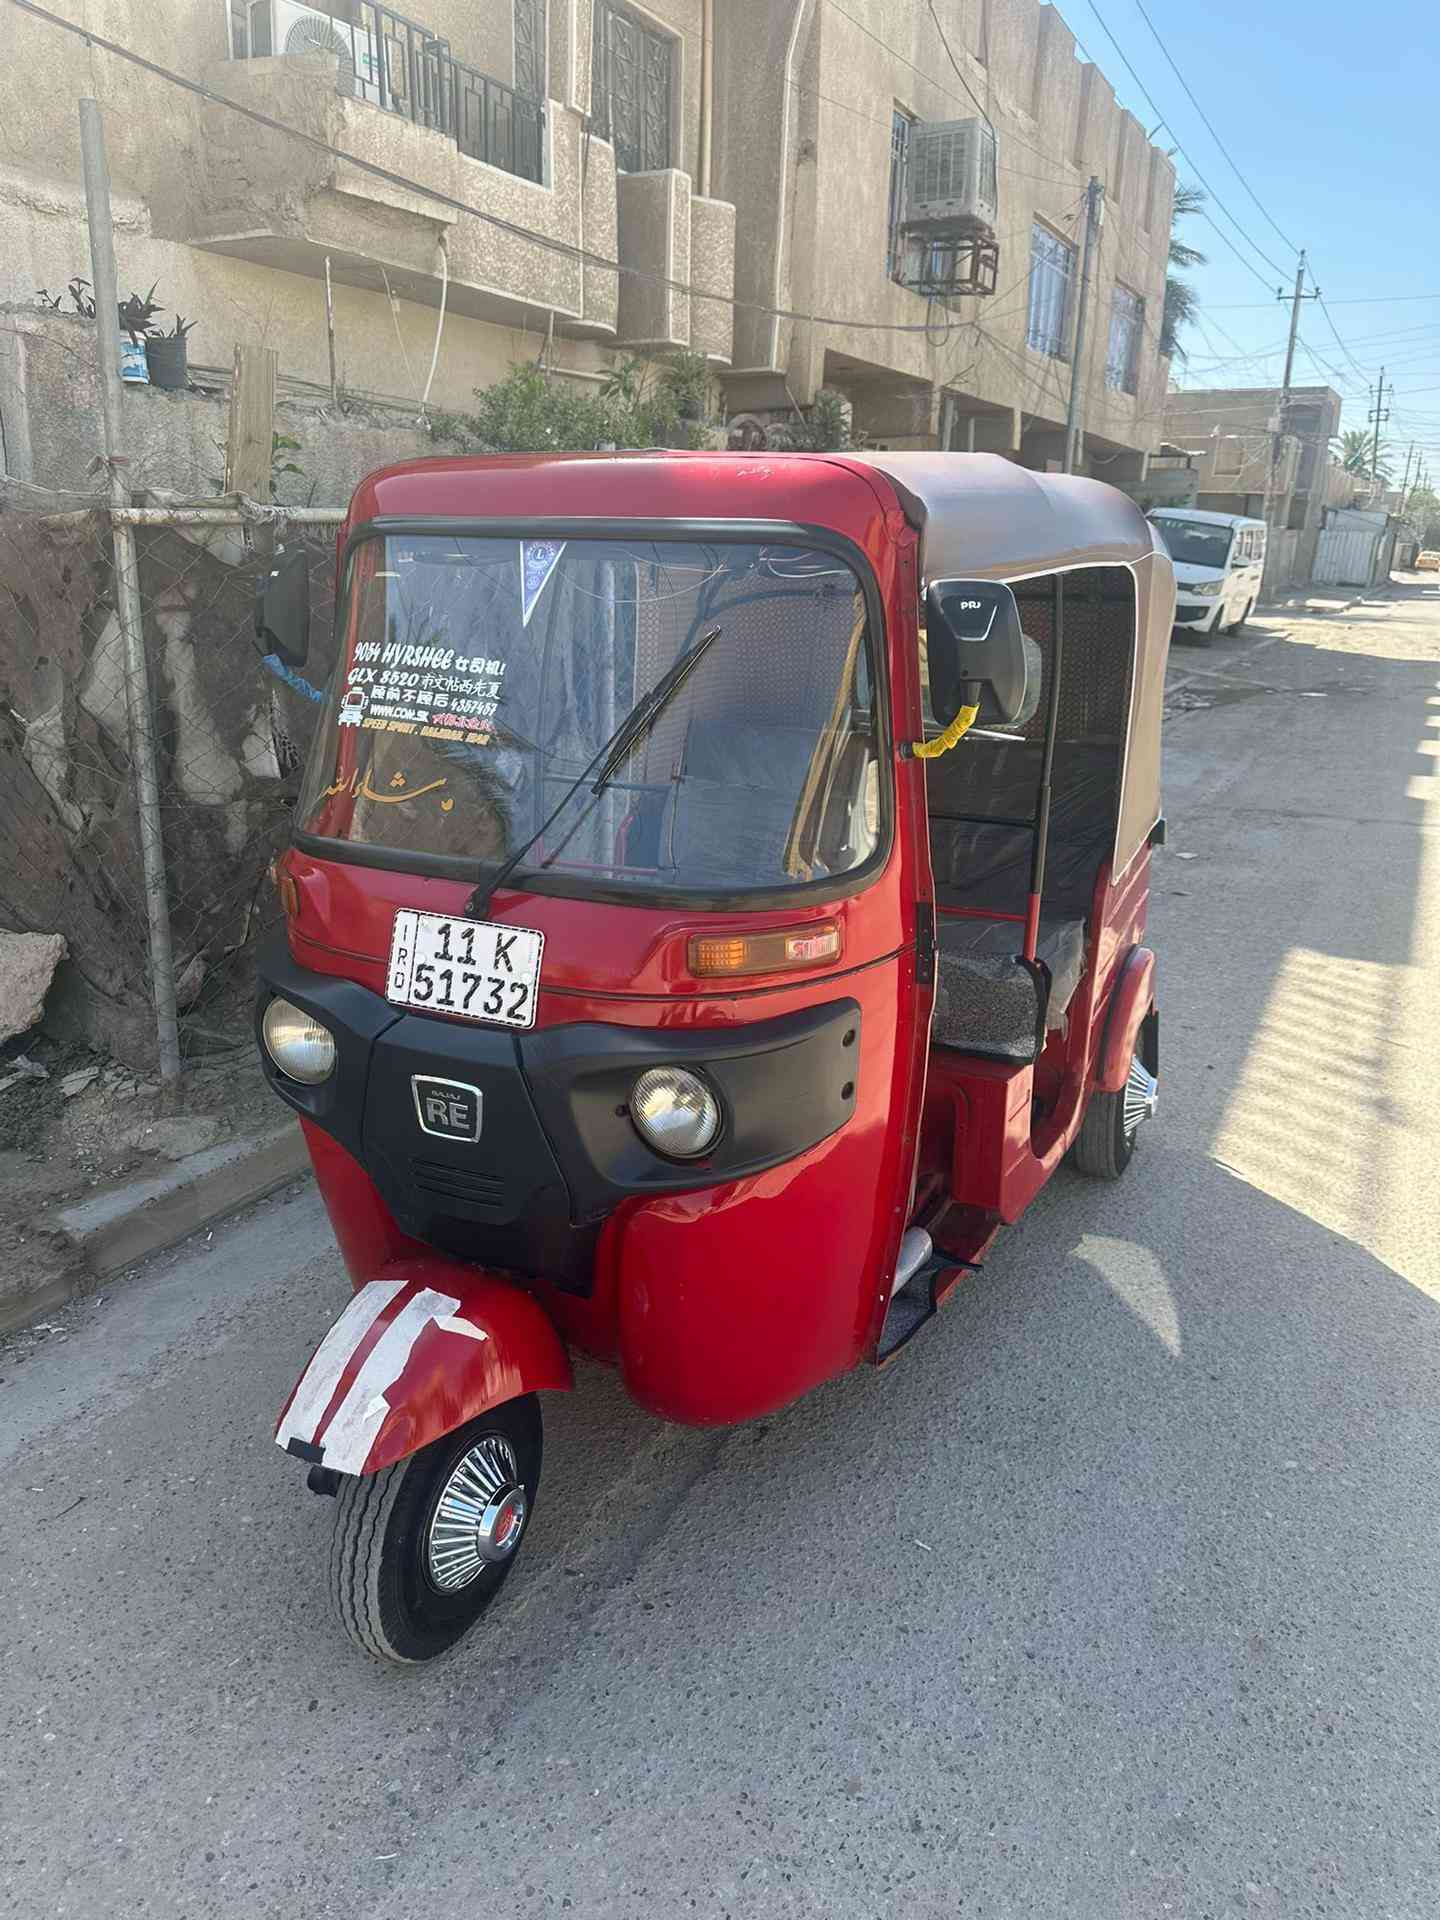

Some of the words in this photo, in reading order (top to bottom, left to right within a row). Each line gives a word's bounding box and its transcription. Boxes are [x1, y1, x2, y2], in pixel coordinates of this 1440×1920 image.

[347, 667, 379, 686] GLX
[380, 670, 420, 687] 8520
[433, 923, 477, 966] 11
[494, 932, 519, 973] K
[413, 963, 530, 1021] 51732
[426, 1097, 471, 1129] RE
